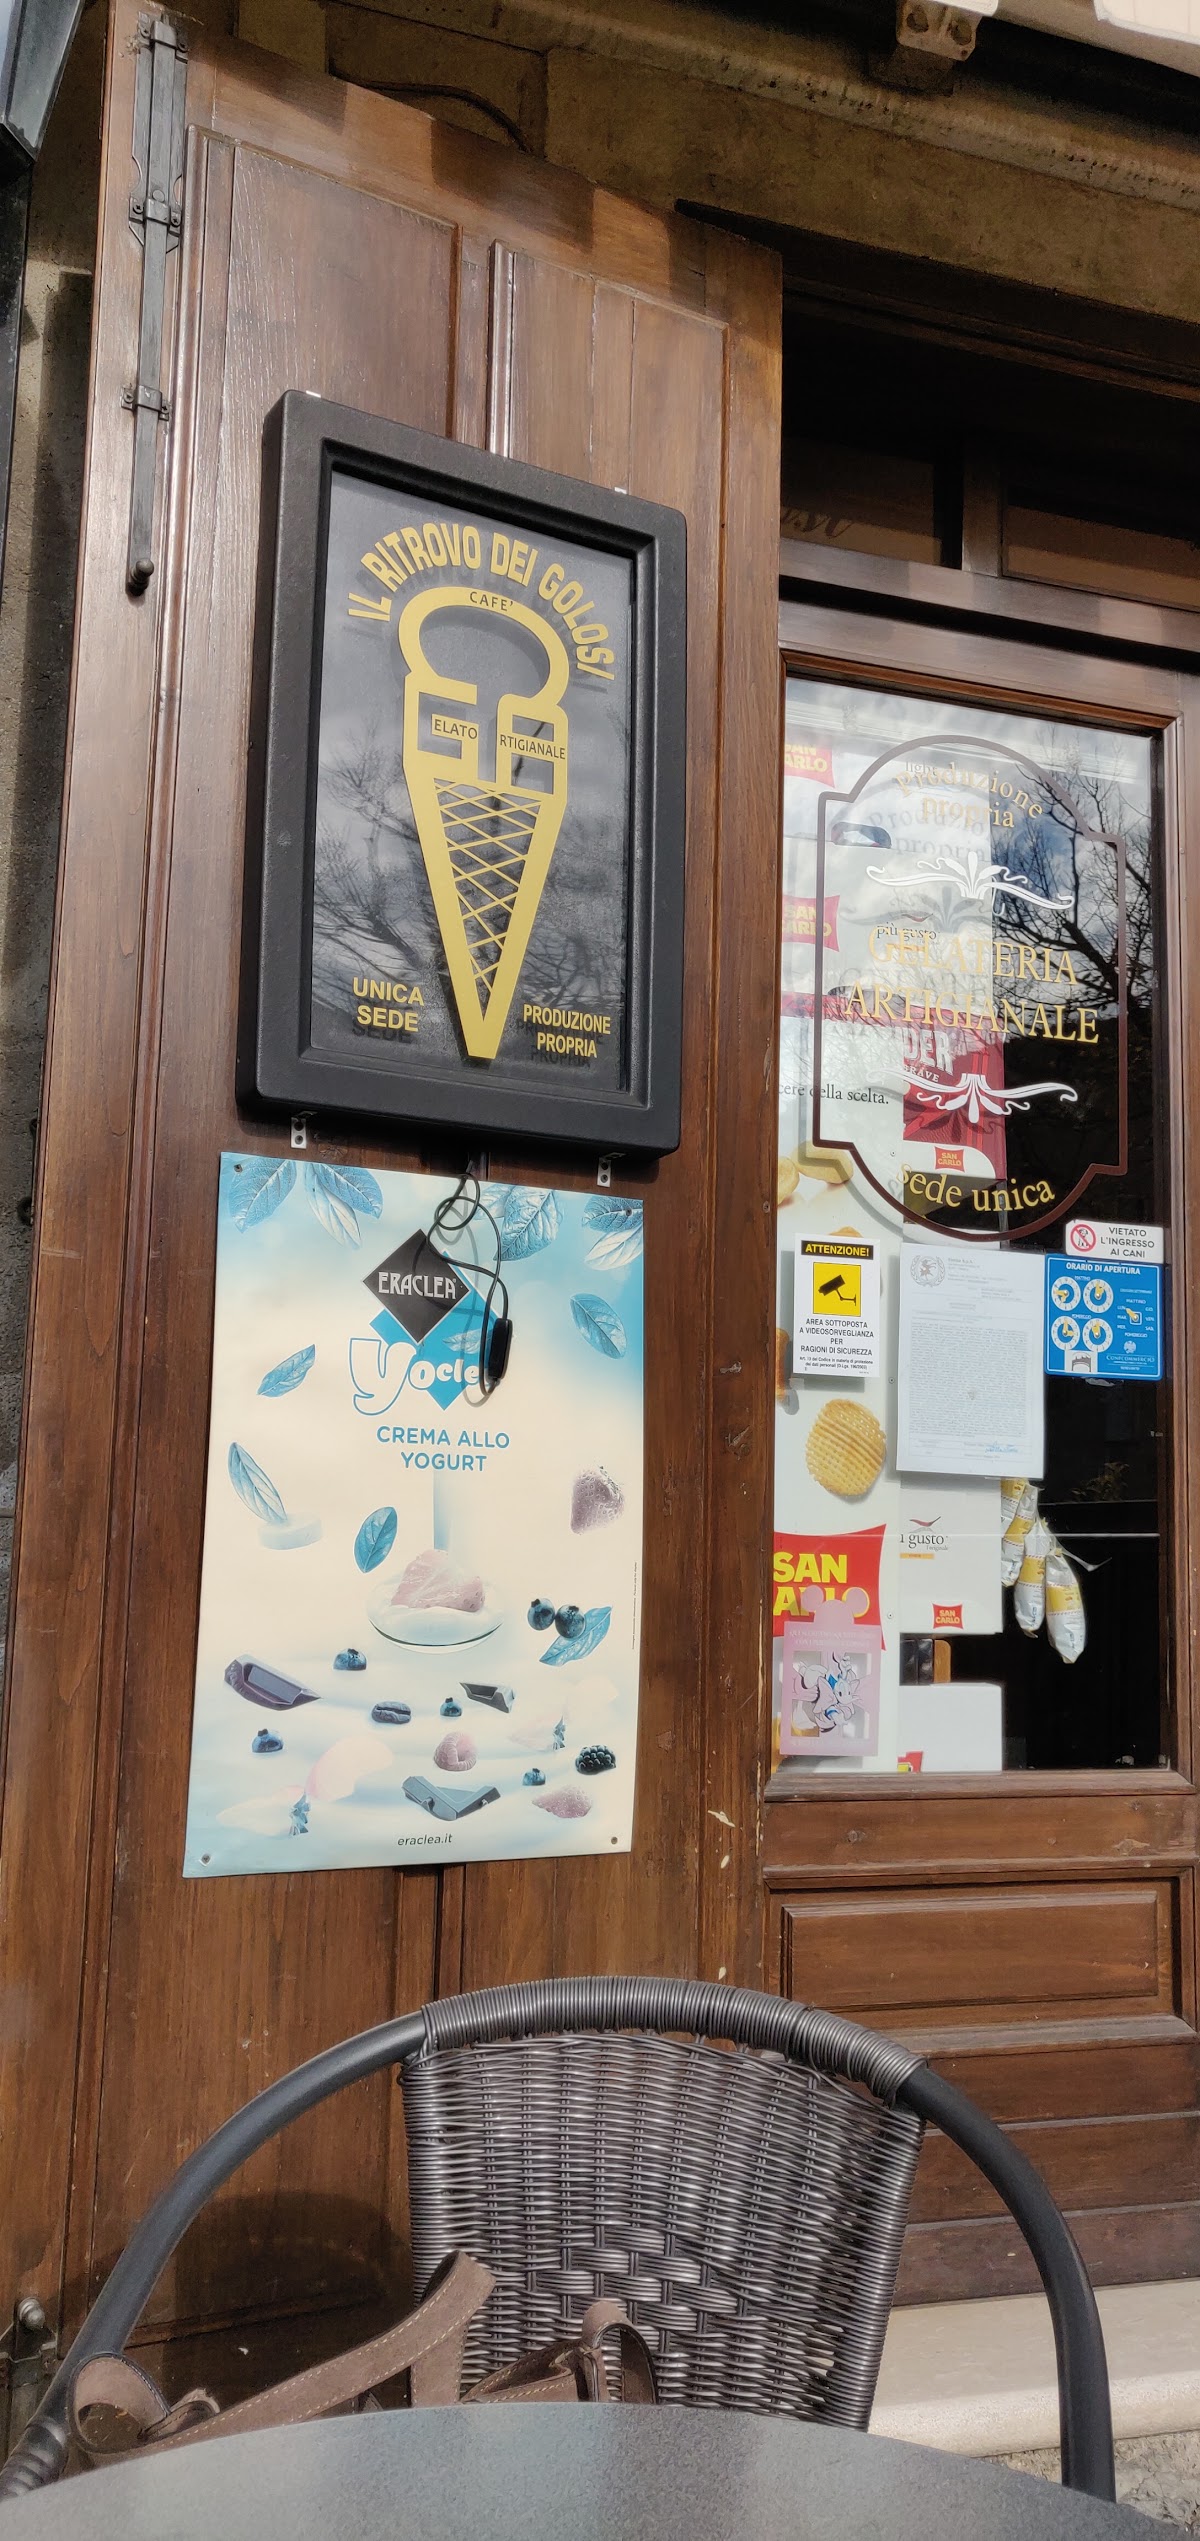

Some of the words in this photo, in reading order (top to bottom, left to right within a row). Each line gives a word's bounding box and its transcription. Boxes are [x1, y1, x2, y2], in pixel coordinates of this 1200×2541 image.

[361, 522, 482, 592] RITROVO
[490, 532, 538, 587] DEI
[348, 592, 393, 622] IL
[538, 563, 615, 681] GOLOSI
[922, 797, 1015, 829] propria
[868, 925, 1079, 986] GELATERIA
[352, 977, 424, 1006] UNICA
[357, 1005, 419, 1032] SEDE
[523, 1003, 611, 1034] PRODUZIONE
[844, 980, 1100, 1044] ARTIGIANALE
[537, 1032, 598, 1058] PROPRIA
[847, 1087, 889, 1105] scelta.
[937, 1158, 962, 1167] CARLO
[941, 1152, 957, 1160] SAN
[971, 1178, 1056, 1212] unica
[1100, 1236, 1155, 1249] L'INGRESSO
[1108, 1226, 1147, 1237] VIETATO
[805, 1244, 869, 1256] ATTENZIONE!
[1110, 1248, 1120, 1256] AI
[1123, 1249, 1146, 1258] CANI
[1066, 1262, 1093, 1272] ORARIO
[1103, 1265, 1141, 1275] APERTURA
[378, 1271, 456, 1300] ERACLEA
[805, 1328, 874, 1337] VIDEOSORVEGLIANZA
[806, 1318, 824, 1326] AREA
[825, 1319, 868, 1328] SOTTOPOSTA
[800, 1345, 828, 1353] RAGIONI
[836, 1347, 873, 1356] SICUREZZA
[830, 1337, 844, 1345] PER
[376, 1425, 451, 1446] CREMA
[457, 1431, 510, 1449] ALLO
[400, 1452, 487, 1472] YOGURT
[908, 1533, 945, 1549] gusto
[773, 1551, 848, 1584] SAN
[397, 1833, 453, 1846] eraclea.it
